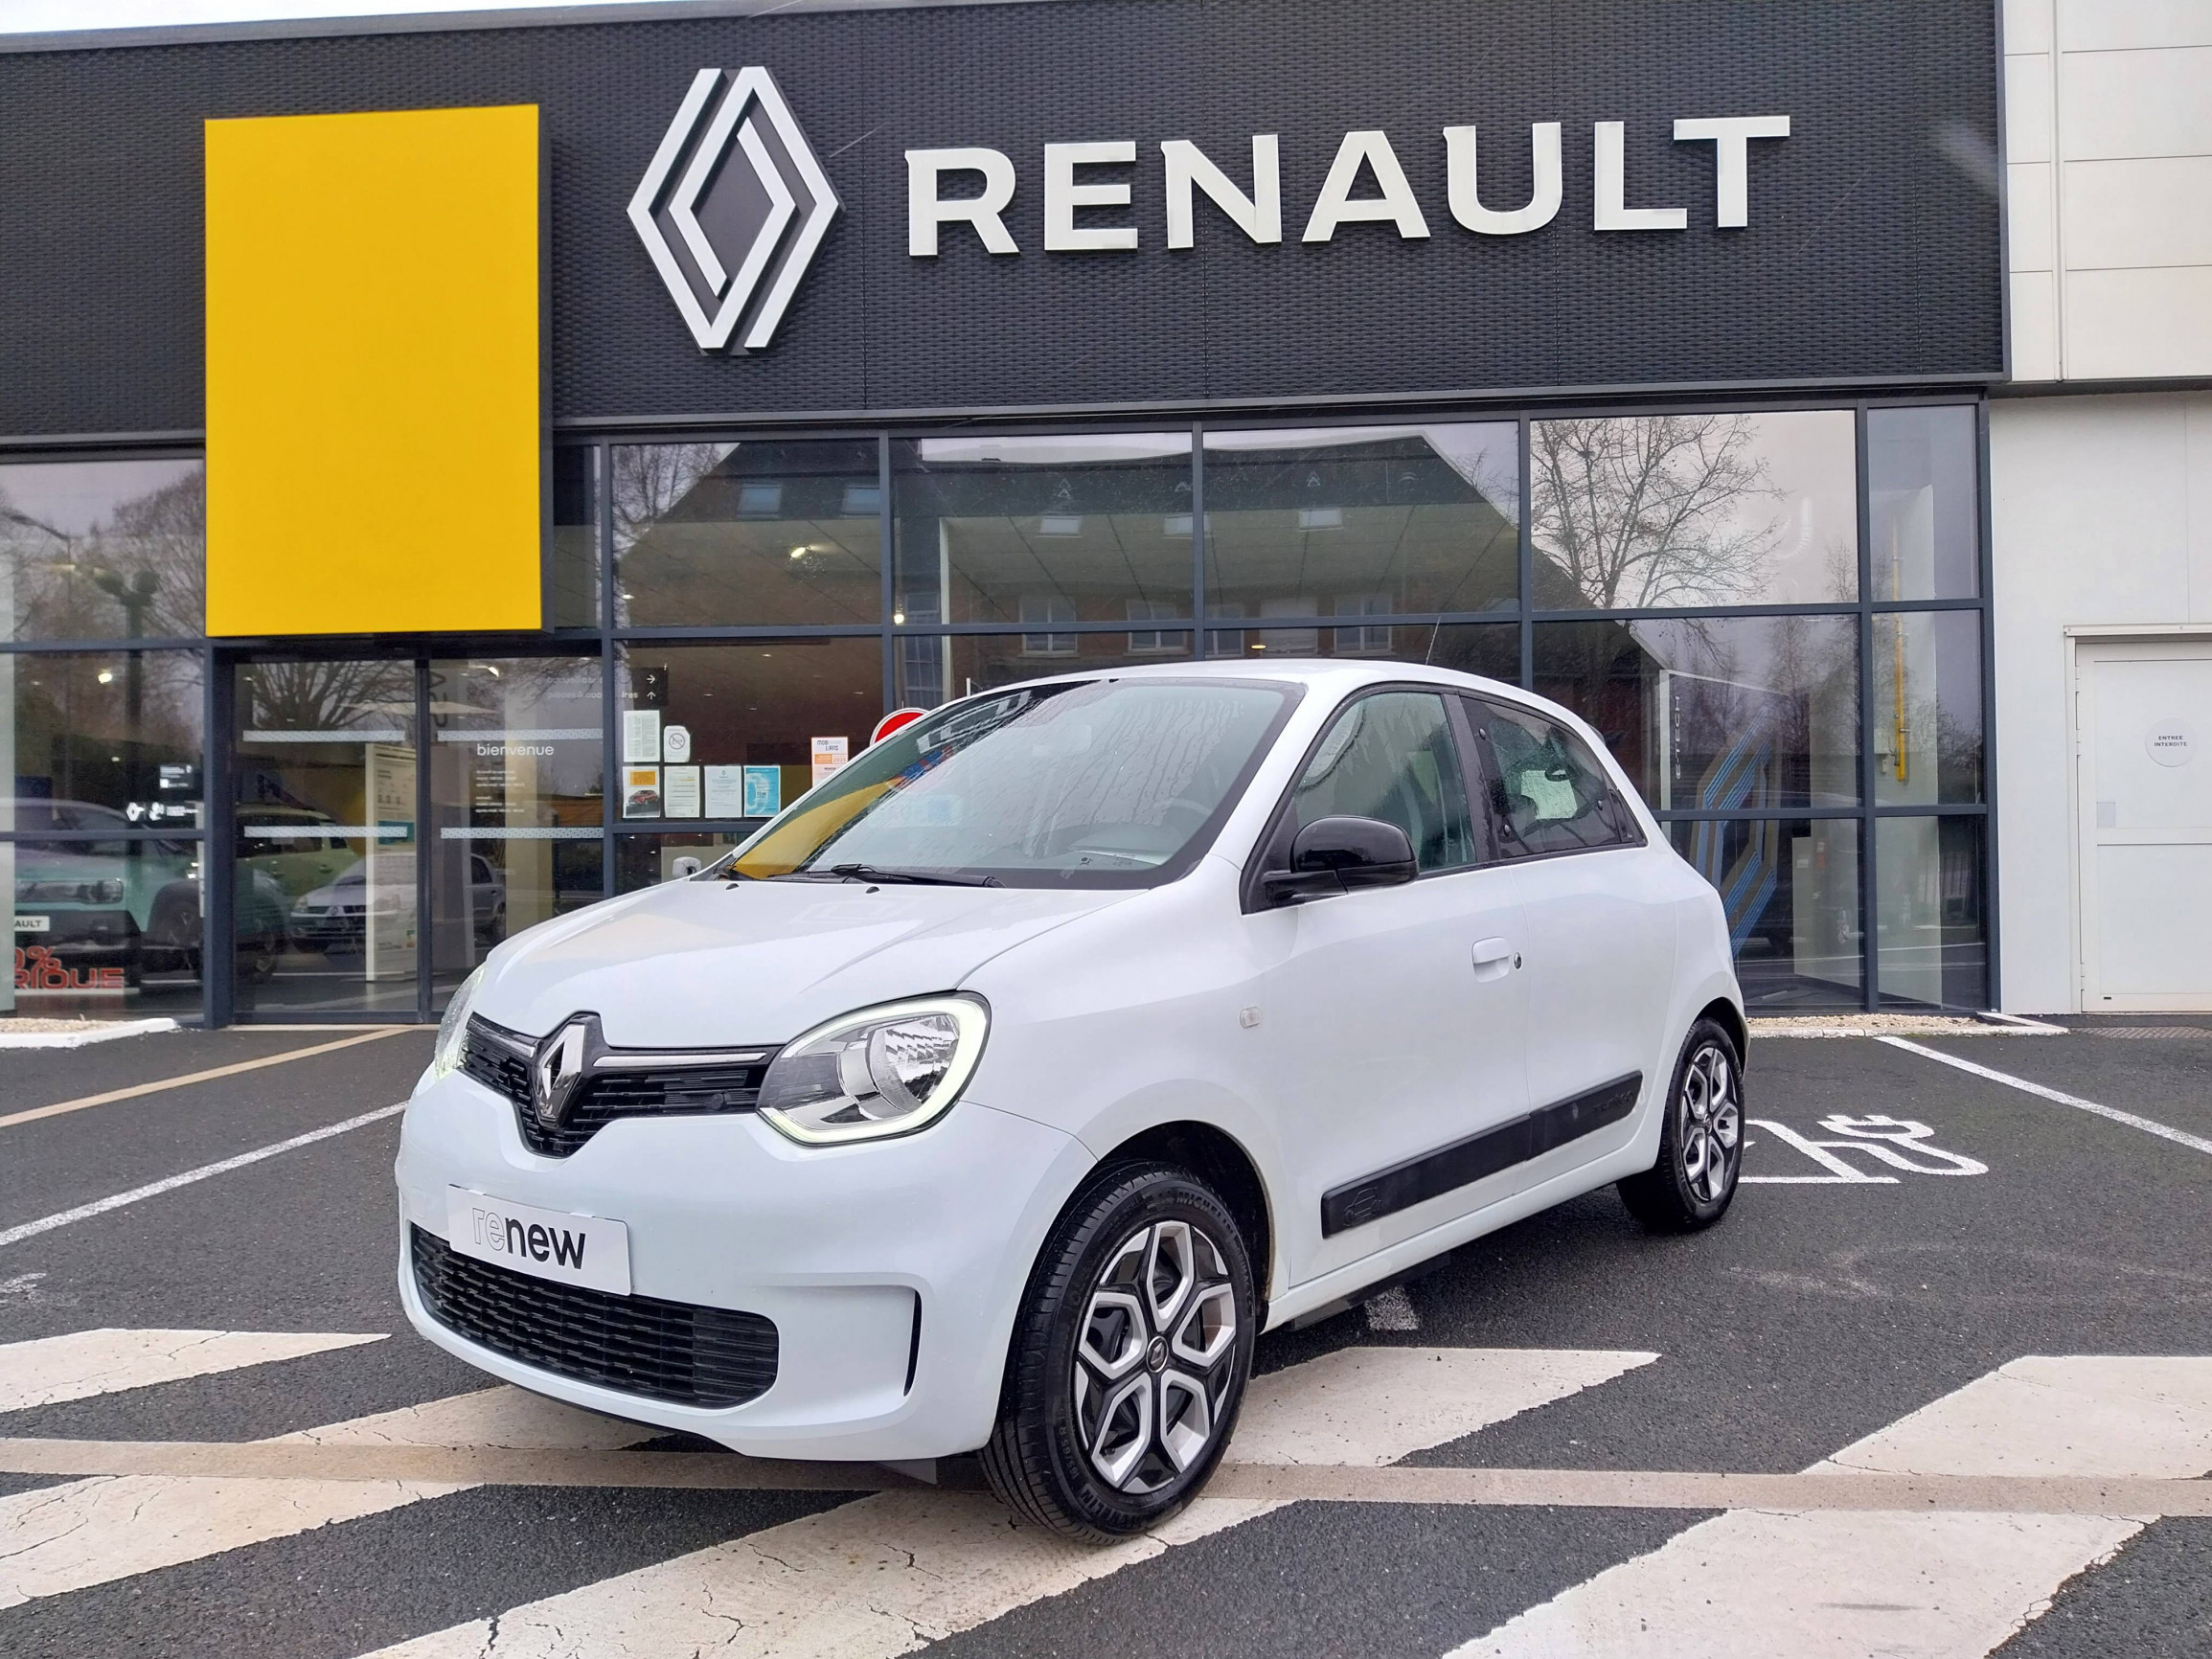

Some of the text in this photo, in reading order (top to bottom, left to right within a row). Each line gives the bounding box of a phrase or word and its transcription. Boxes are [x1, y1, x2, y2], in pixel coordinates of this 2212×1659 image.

[904, 115, 1790, 258] RENAULT
[477, 743, 555, 757] bienvenue
[14, 920, 42, 928] AULT
[472, 1207, 586, 1270] renew
[1176, 1191, 1237, 1239] MICHELIN
